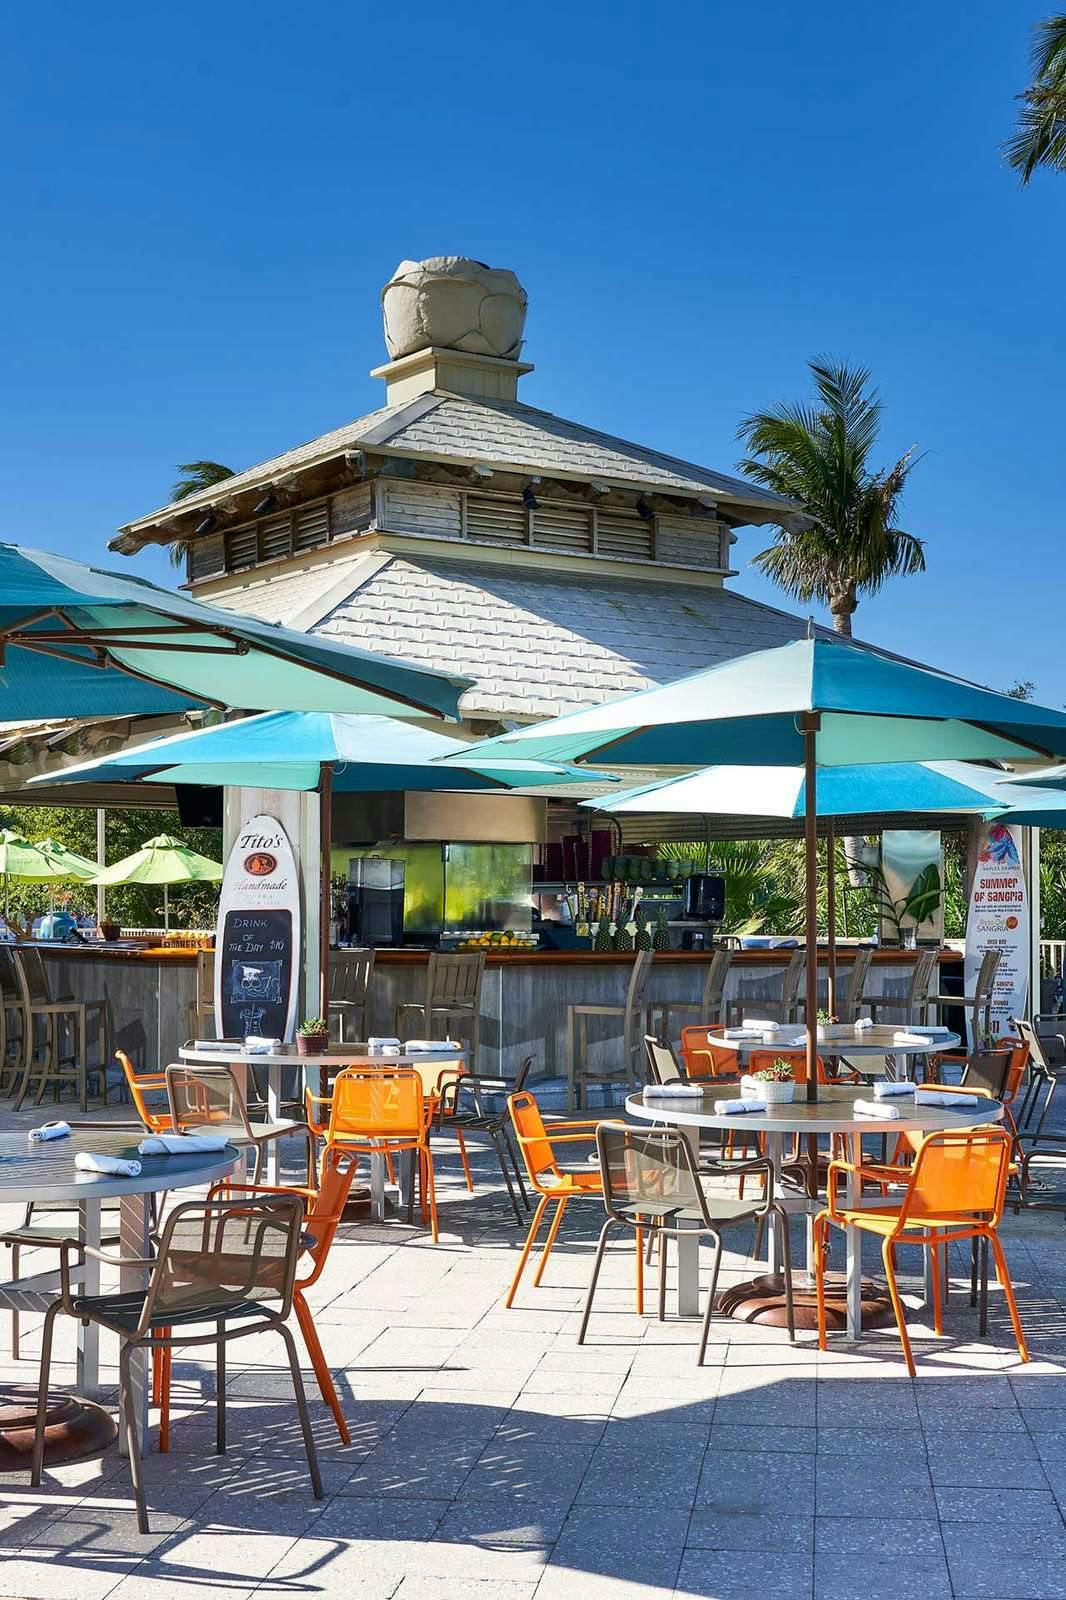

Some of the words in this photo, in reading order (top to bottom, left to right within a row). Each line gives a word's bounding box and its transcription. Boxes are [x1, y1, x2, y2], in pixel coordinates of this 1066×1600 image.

[240, 834, 283, 848] Tito's
[233, 878, 287, 890] Handmade
[974, 892, 985, 902] OF
[987, 891, 1023, 902] SANGRIA
[233, 918, 268, 928] DRINK
[229, 943, 242, 952] THE
[245, 942, 264, 952] DAY
